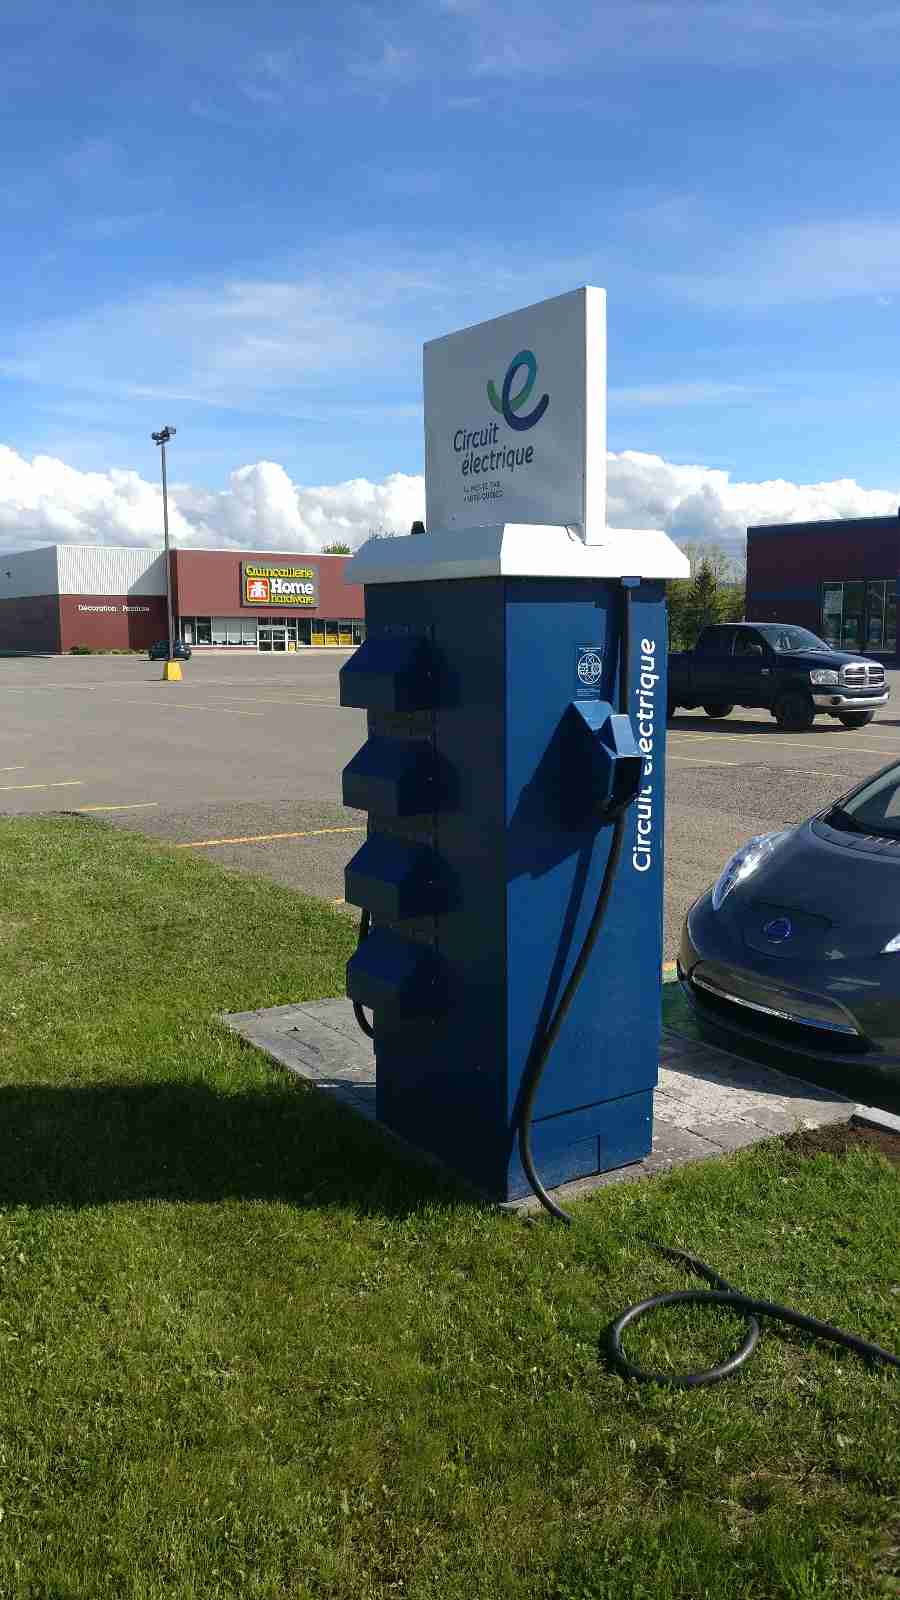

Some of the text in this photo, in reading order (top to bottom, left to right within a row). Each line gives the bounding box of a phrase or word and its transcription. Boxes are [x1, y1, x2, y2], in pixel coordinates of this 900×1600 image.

[453, 422, 499, 452] Circuit
[462, 444, 534, 476] électrique
[270, 578, 314, 595] Home
